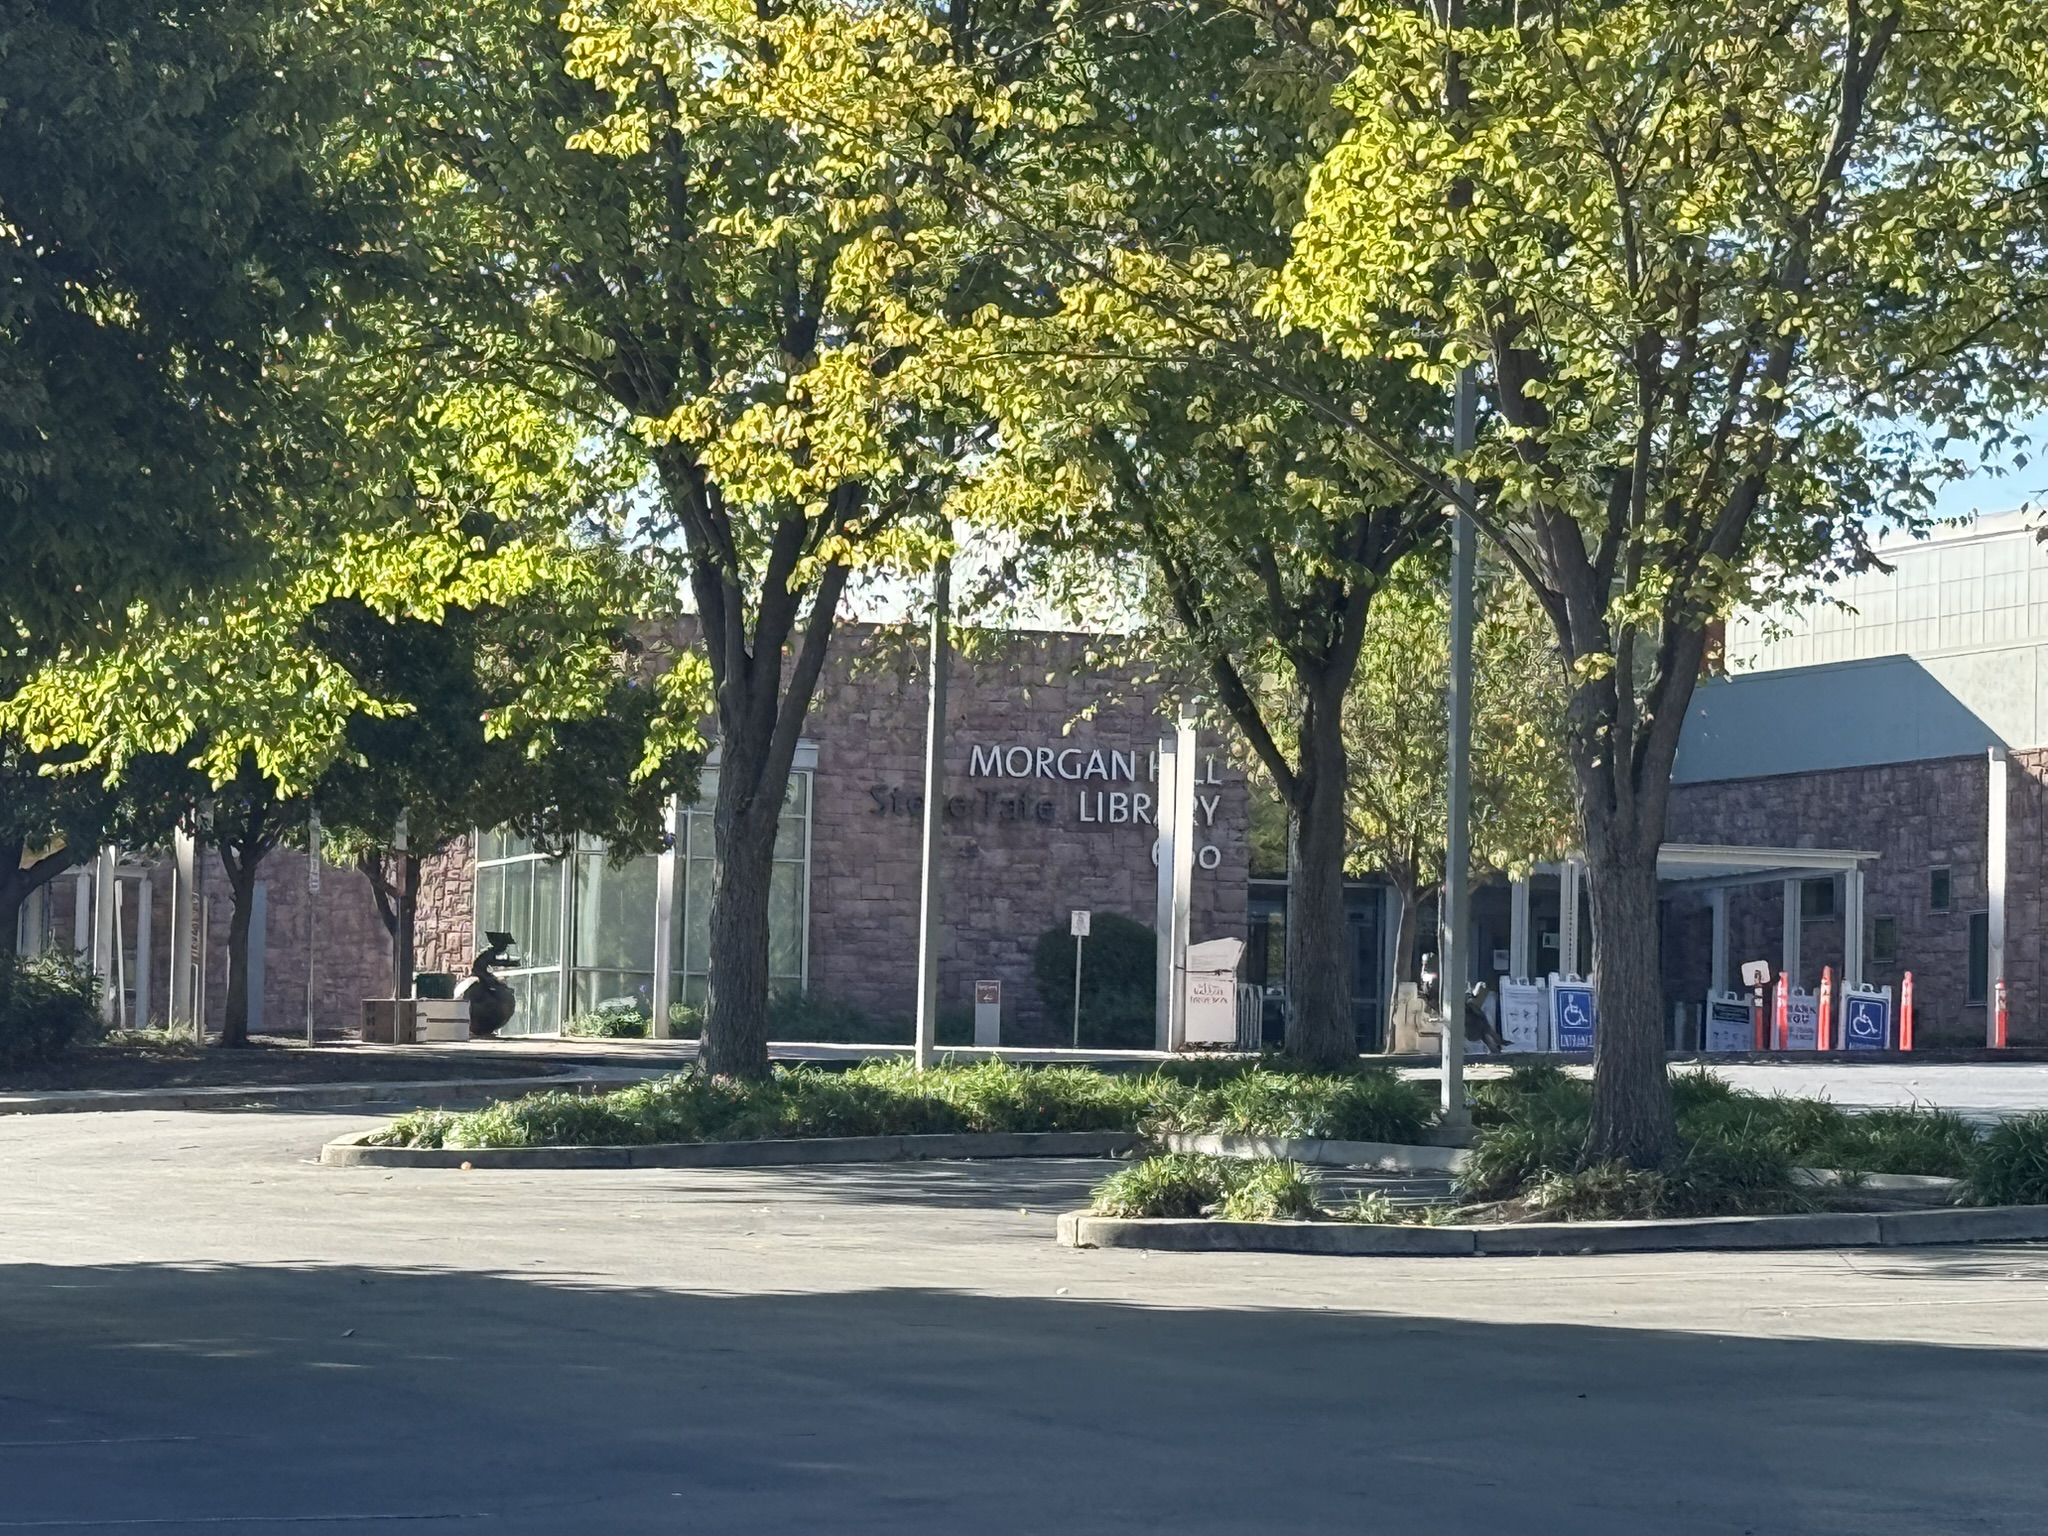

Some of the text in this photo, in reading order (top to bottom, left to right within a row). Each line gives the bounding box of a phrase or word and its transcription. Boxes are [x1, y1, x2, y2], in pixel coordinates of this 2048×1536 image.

[968, 744, 1222, 785] MORGAN HL
[1079, 790, 1221, 827] LIBRY
